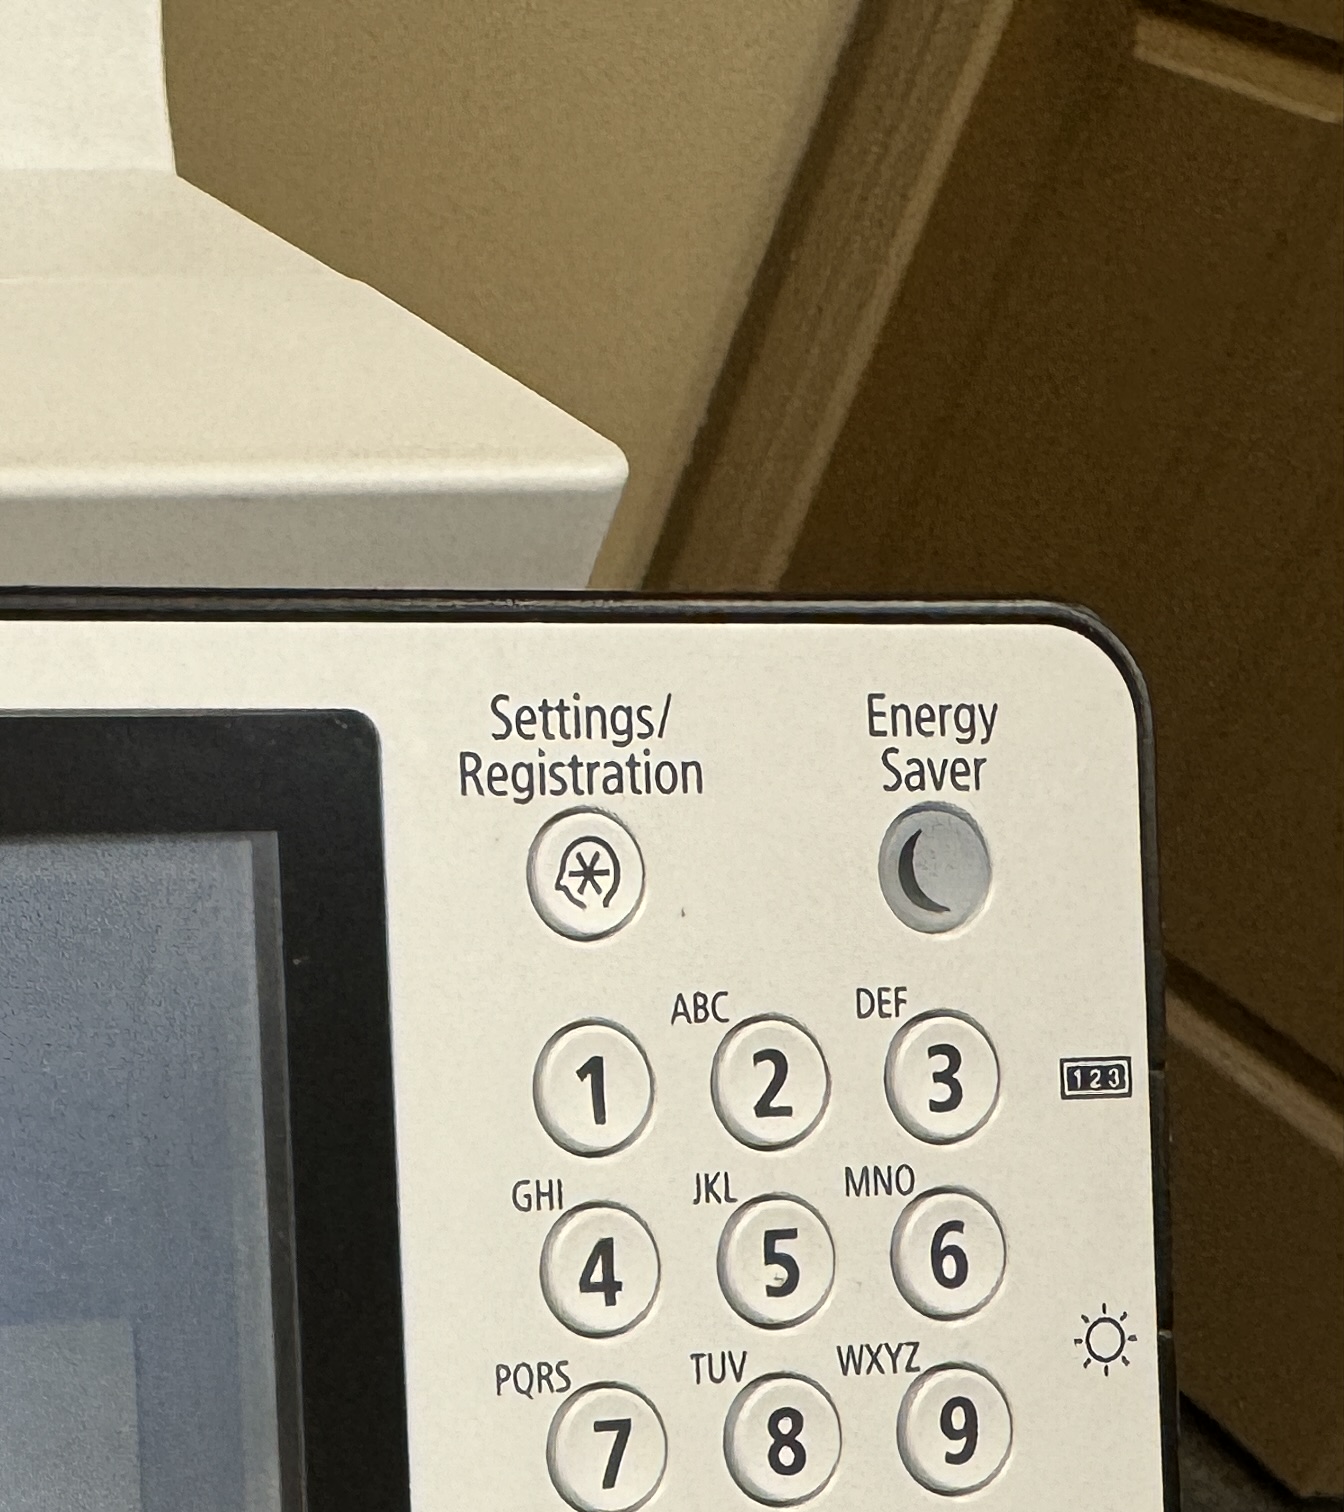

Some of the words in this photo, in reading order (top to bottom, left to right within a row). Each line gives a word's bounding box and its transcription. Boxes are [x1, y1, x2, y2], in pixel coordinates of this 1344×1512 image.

[491, 693, 671, 747] Settings/
[868, 693, 998, 744] Energy
[459, 750, 704, 803] Registration
[882, 748, 987, 792] Saver
[671, 991, 729, 1025] ABC
[856, 986, 907, 1019] DEF
[576, 1056, 606, 1125] 1
[753, 1049, 792, 1117] 2
[928, 1044, 963, 1112] 3
[1073, 1067, 1120, 1090] 123
[512, 1179, 564, 1212] GHI
[693, 1172, 738, 1205] JKL
[845, 1164, 915, 1198] MNO
[579, 1237, 622, 1306] 4
[764, 1228, 799, 1297] 5
[931, 1220, 968, 1289] 6
[496, 1360, 572, 1399] PQRS
[690, 1351, 748, 1385] TUV
[837, 1341, 922, 1376] WXYZ
[594, 1418, 631, 1489] 7
[768, 1407, 806, 1475] 8
[940, 1396, 978, 1465] 9
